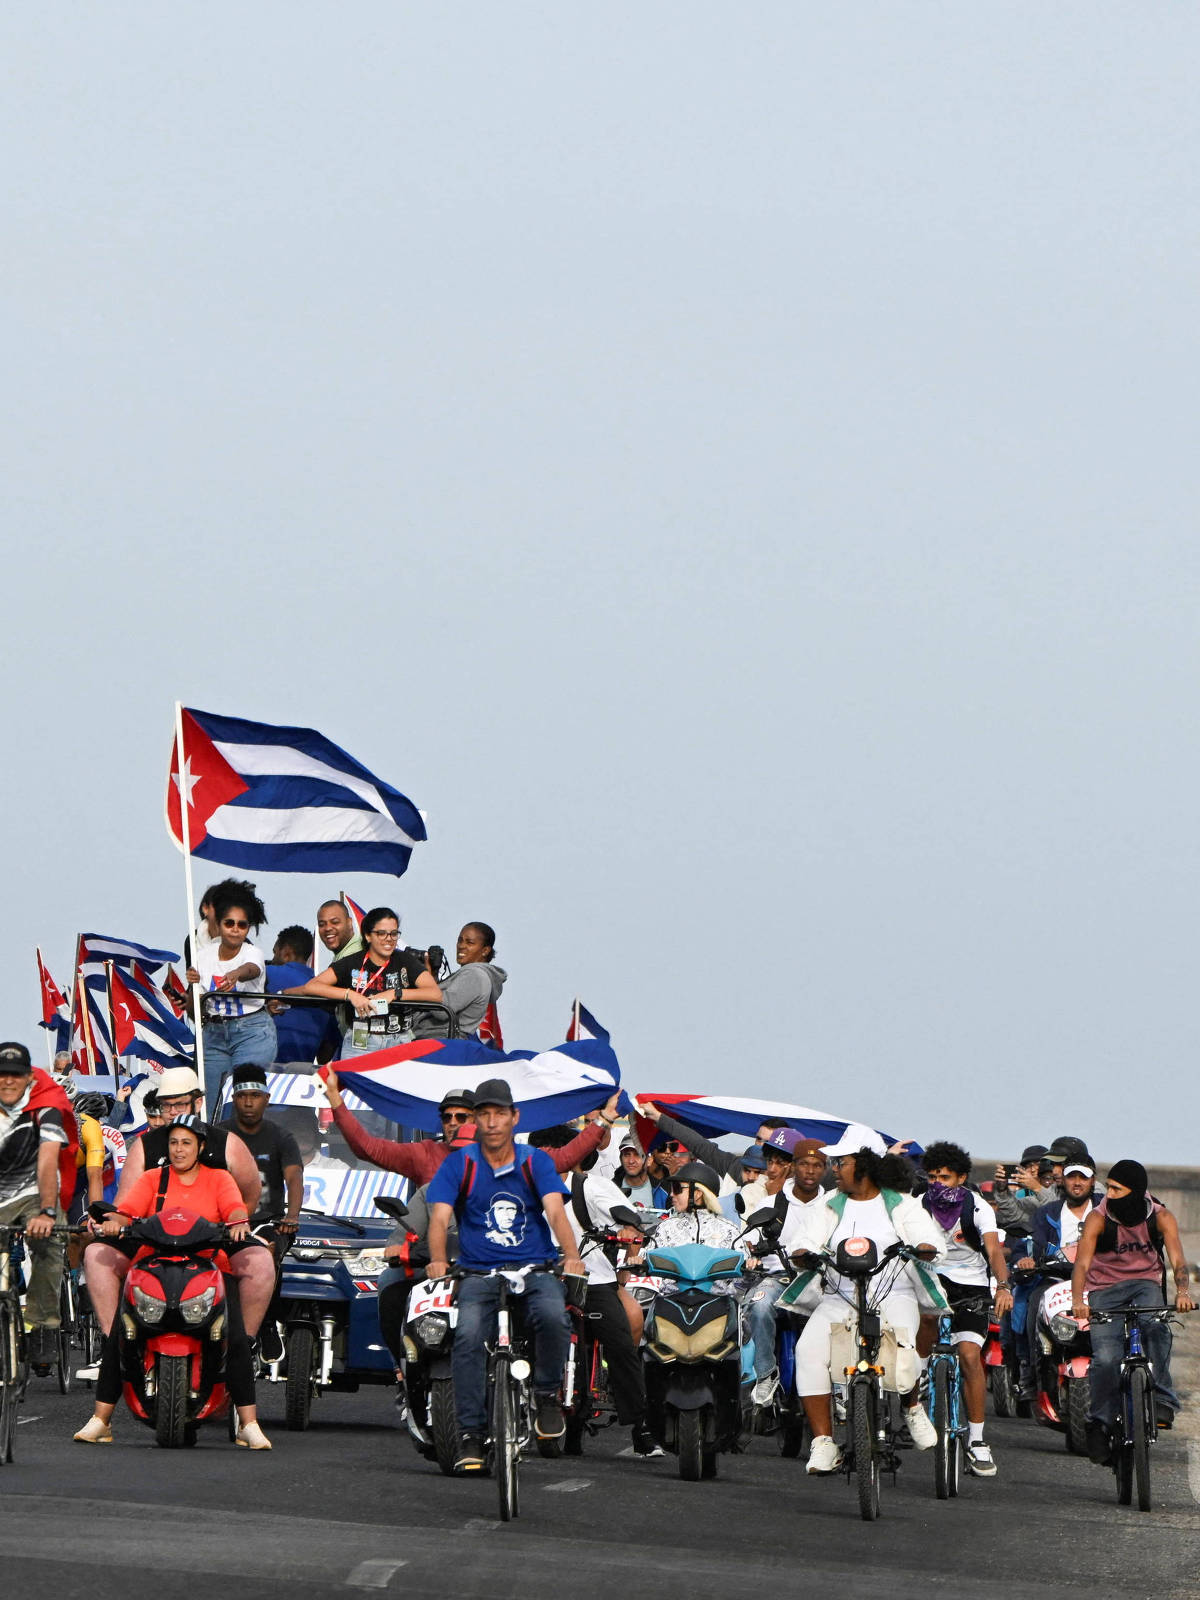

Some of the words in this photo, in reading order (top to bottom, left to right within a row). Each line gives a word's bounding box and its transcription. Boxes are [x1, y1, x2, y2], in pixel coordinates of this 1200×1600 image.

[101, 1127, 125, 1150] CUBA
[423, 1279, 451, 1295] VI
[414, 1293, 453, 1314] CU
